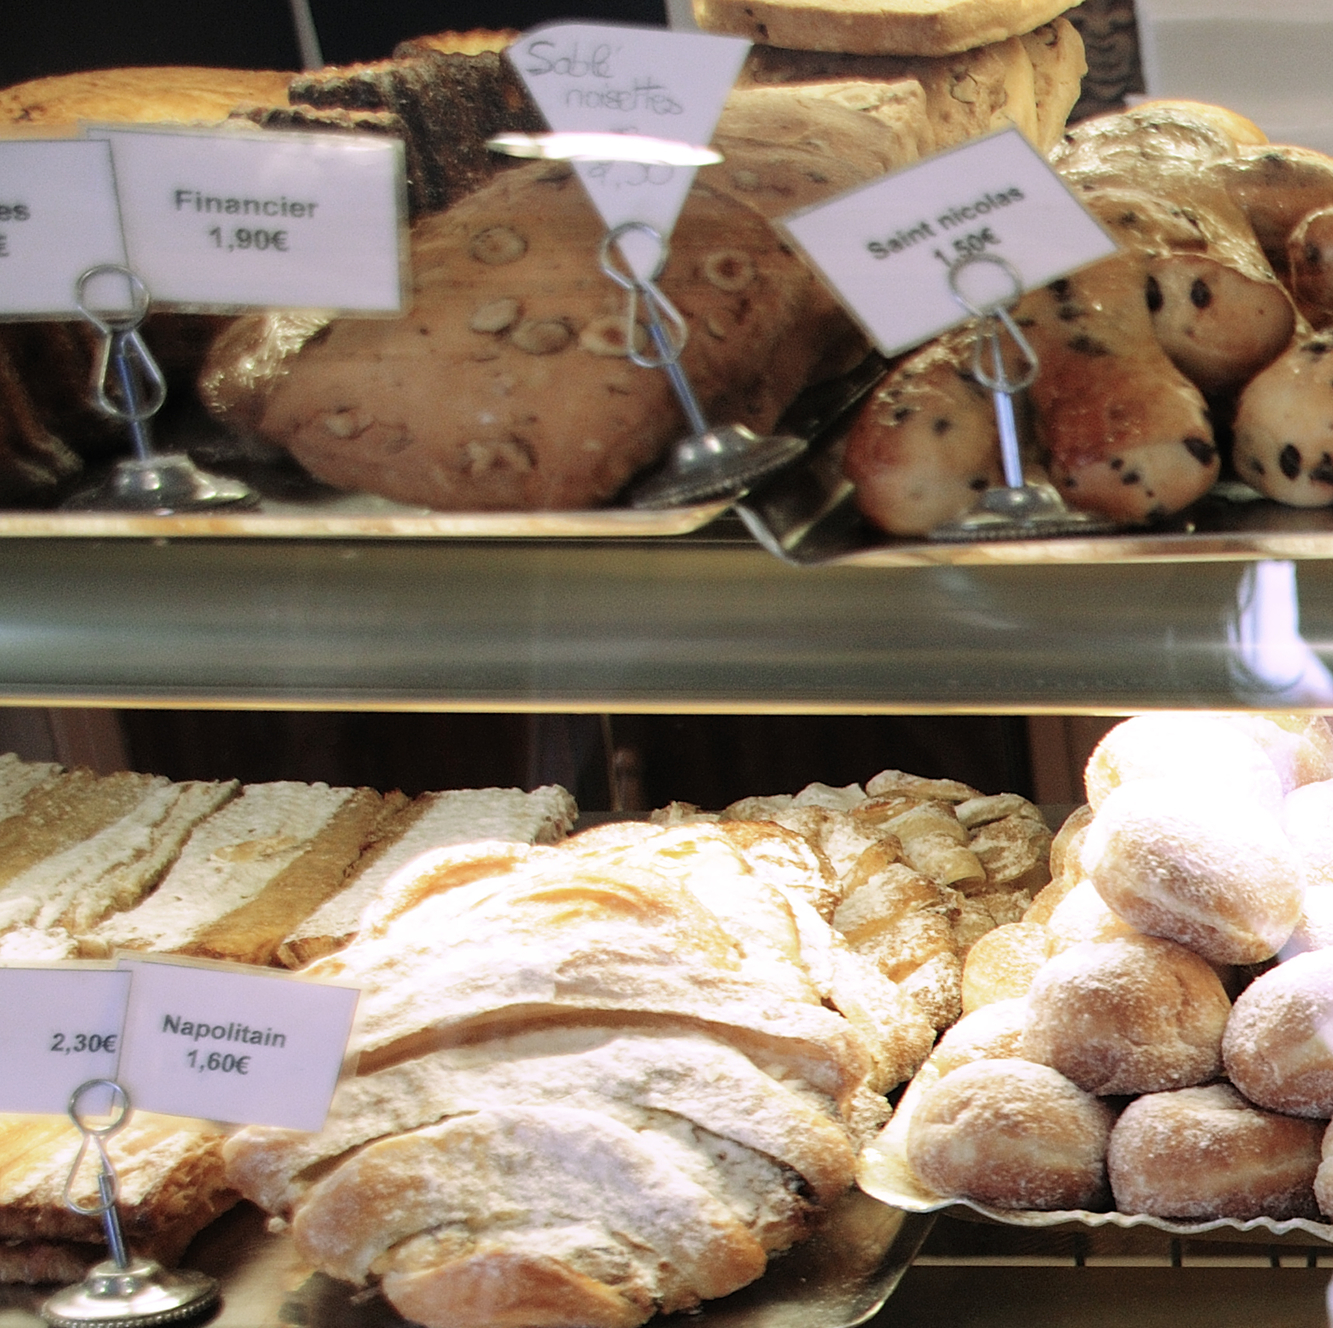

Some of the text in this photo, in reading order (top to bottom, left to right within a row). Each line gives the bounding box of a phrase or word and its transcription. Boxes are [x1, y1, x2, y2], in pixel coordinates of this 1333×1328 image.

[174, 189, 318, 218] Financier
[867, 186, 1025, 260] Saint nicolas
[209, 226, 290, 253] 1,90€
[51, 1033, 118, 1054] 2,30€
[161, 1014, 287, 1048] Napolitain
[187, 1050, 251, 1075] 1,60€
